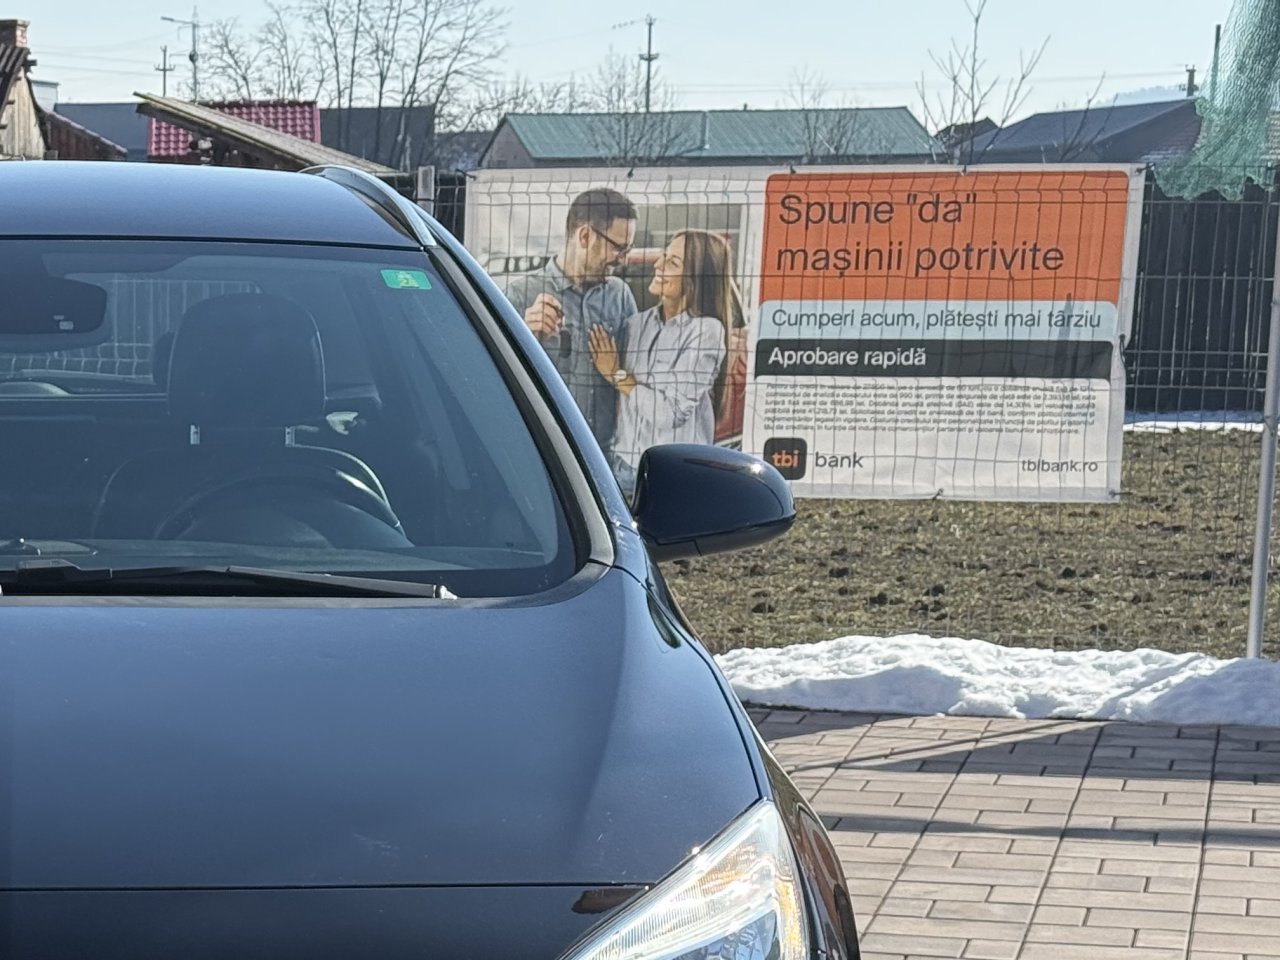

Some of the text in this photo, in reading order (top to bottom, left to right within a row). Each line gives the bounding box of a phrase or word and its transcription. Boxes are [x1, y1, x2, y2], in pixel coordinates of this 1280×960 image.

[778, 193, 977, 230] Spune "da"
[776, 241, 1065, 278] mașinii potrivite
[772, 309, 1101, 332] Cumperi acum, plătești mai târziu
[768, 347, 927, 369] Aprobare rapidă
[772, 450, 863, 468] tbi bank
